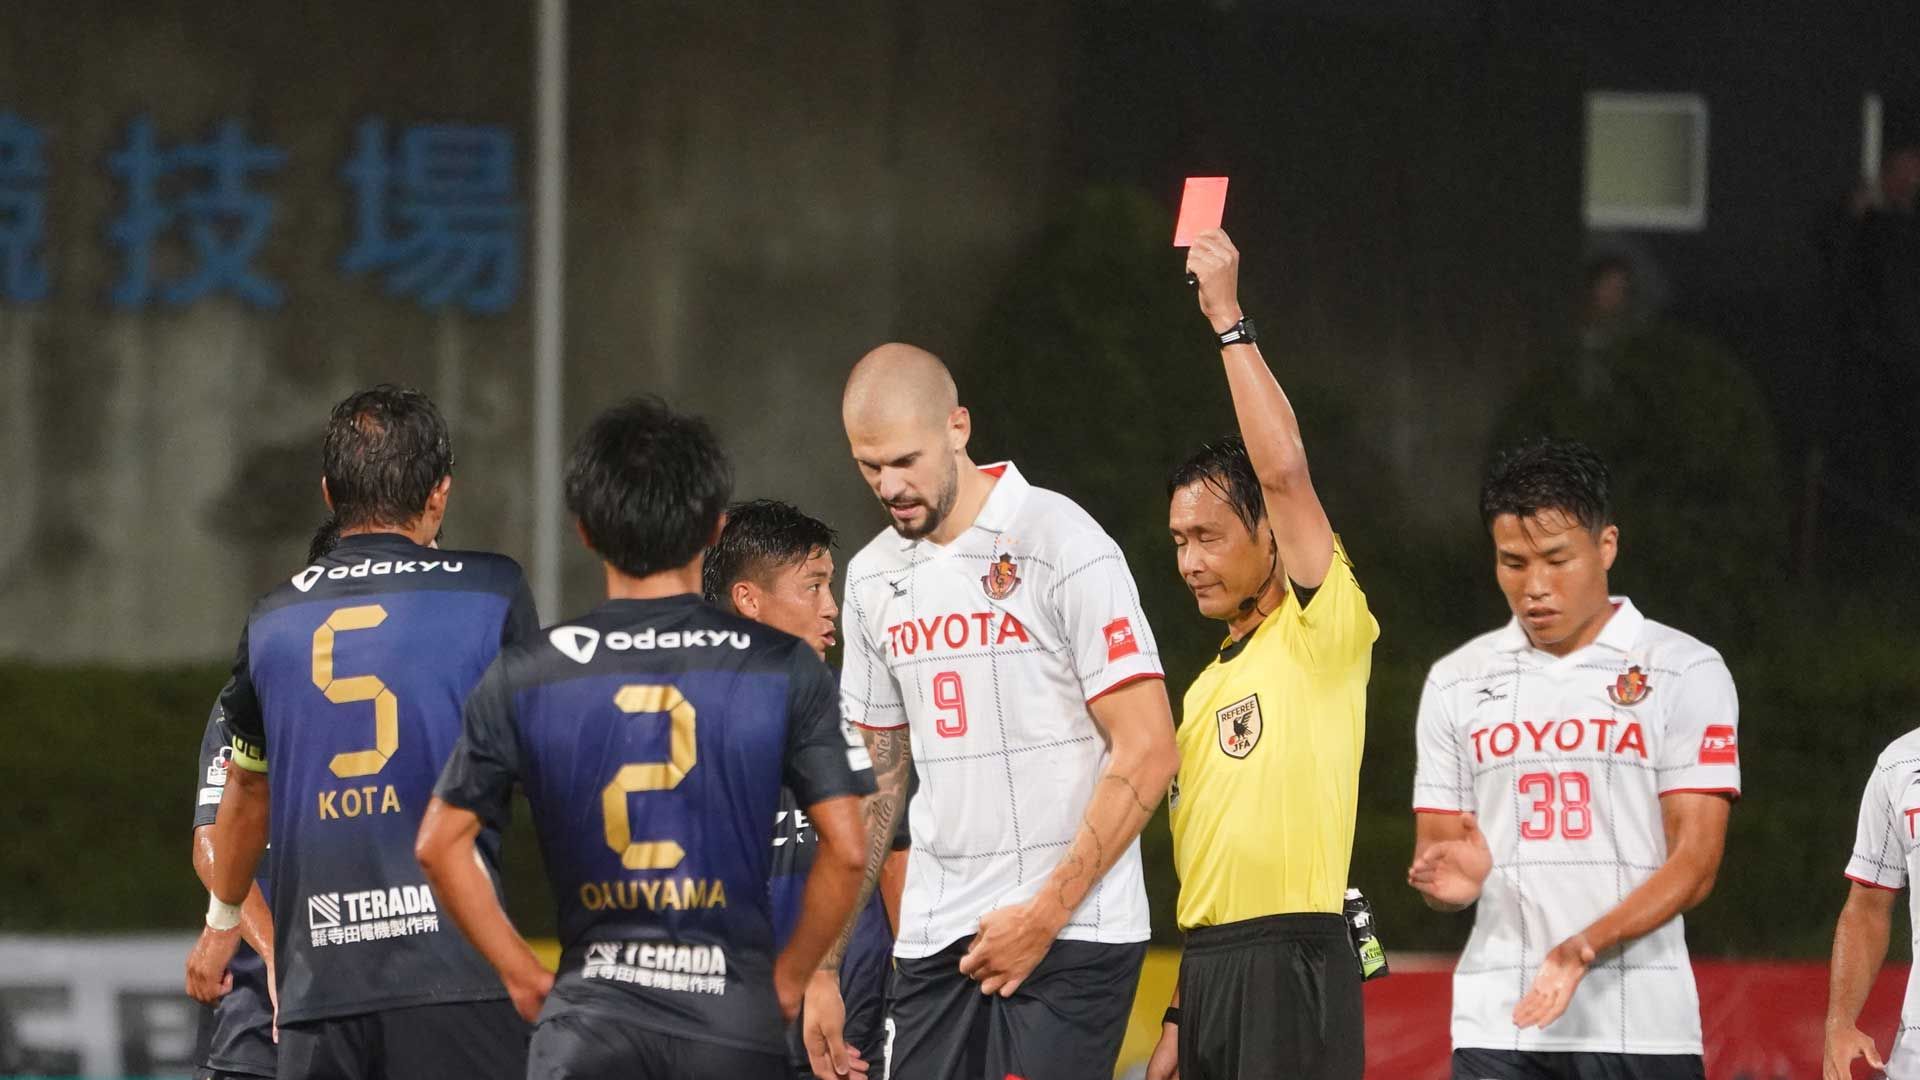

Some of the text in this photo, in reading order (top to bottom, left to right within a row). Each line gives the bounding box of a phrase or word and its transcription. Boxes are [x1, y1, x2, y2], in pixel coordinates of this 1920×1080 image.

[0, 112, 522, 312] 技場
[888, 611, 1030, 658] TOYOTA
[312, 604, 399, 779] 5
[933, 670, 968, 739] 9
[1221, 701, 1255, 722] REFEREE
[1233, 740, 1250, 752] JFA
[1470, 718, 1649, 764] TOYOTA
[602, 684, 697, 870] 2
[319, 785, 401, 820] KOTA
[1518, 771, 1591, 841] 38
[343, 884, 437, 922] TERADA
